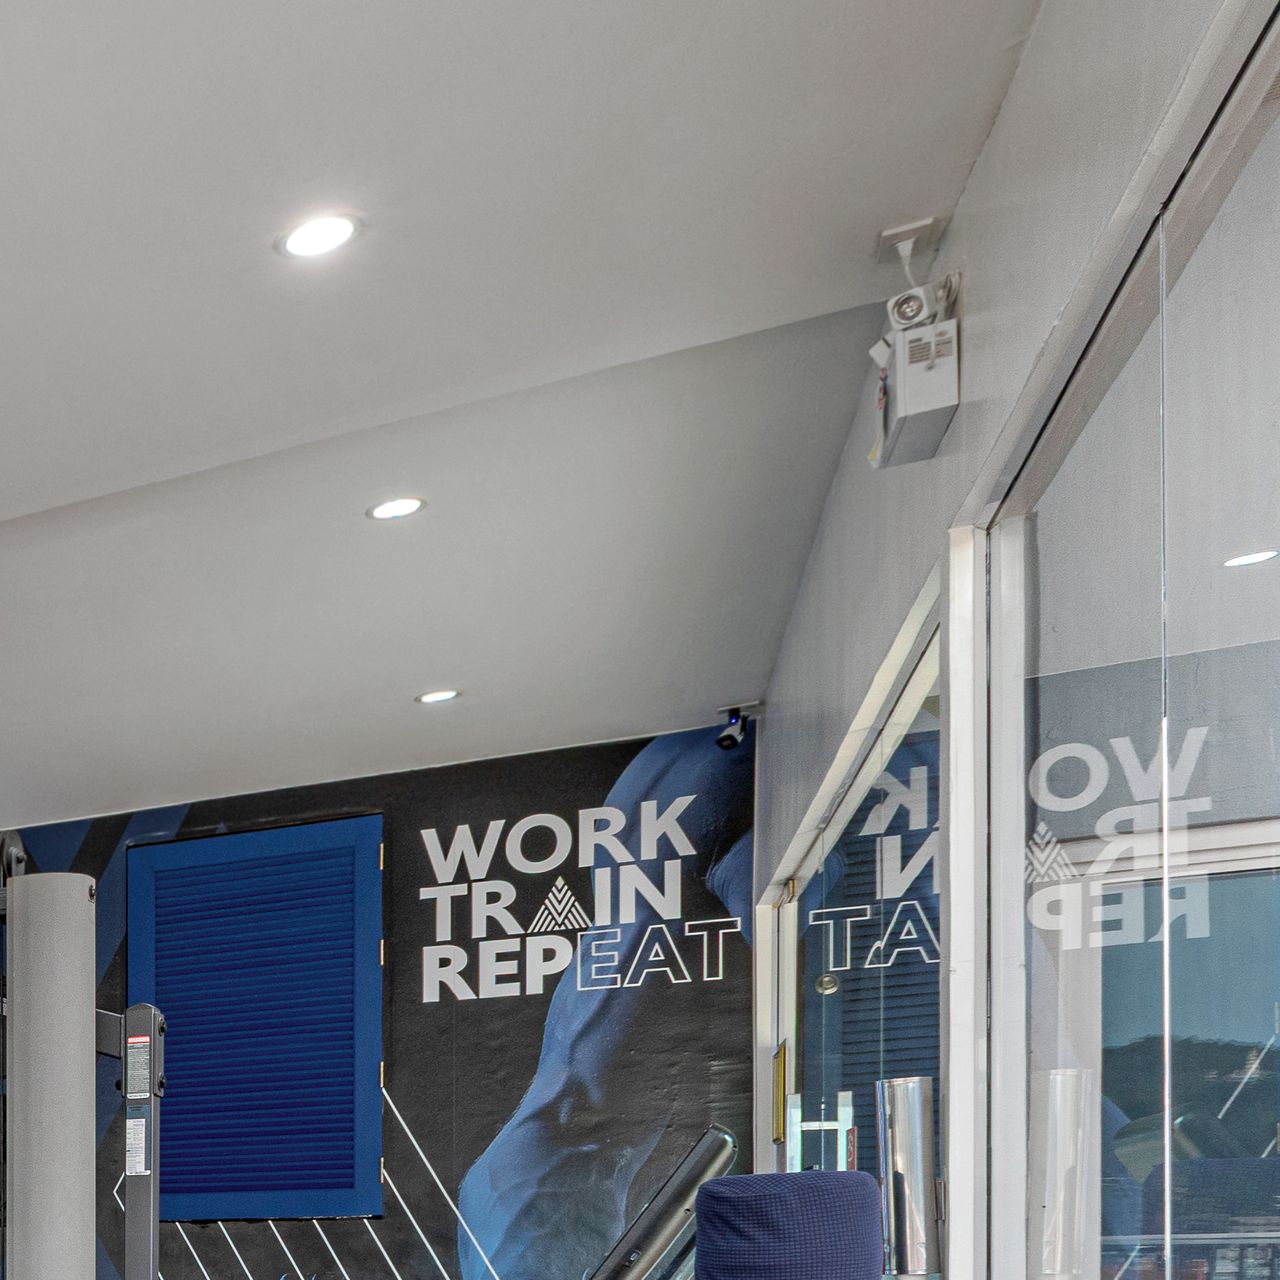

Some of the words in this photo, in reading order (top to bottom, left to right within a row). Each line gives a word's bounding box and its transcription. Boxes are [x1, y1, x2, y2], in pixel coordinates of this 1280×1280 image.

[420, 795, 697, 884] WORK
[419, 859, 682, 943] TRAIN
[421, 917, 742, 1003] REPEAT
